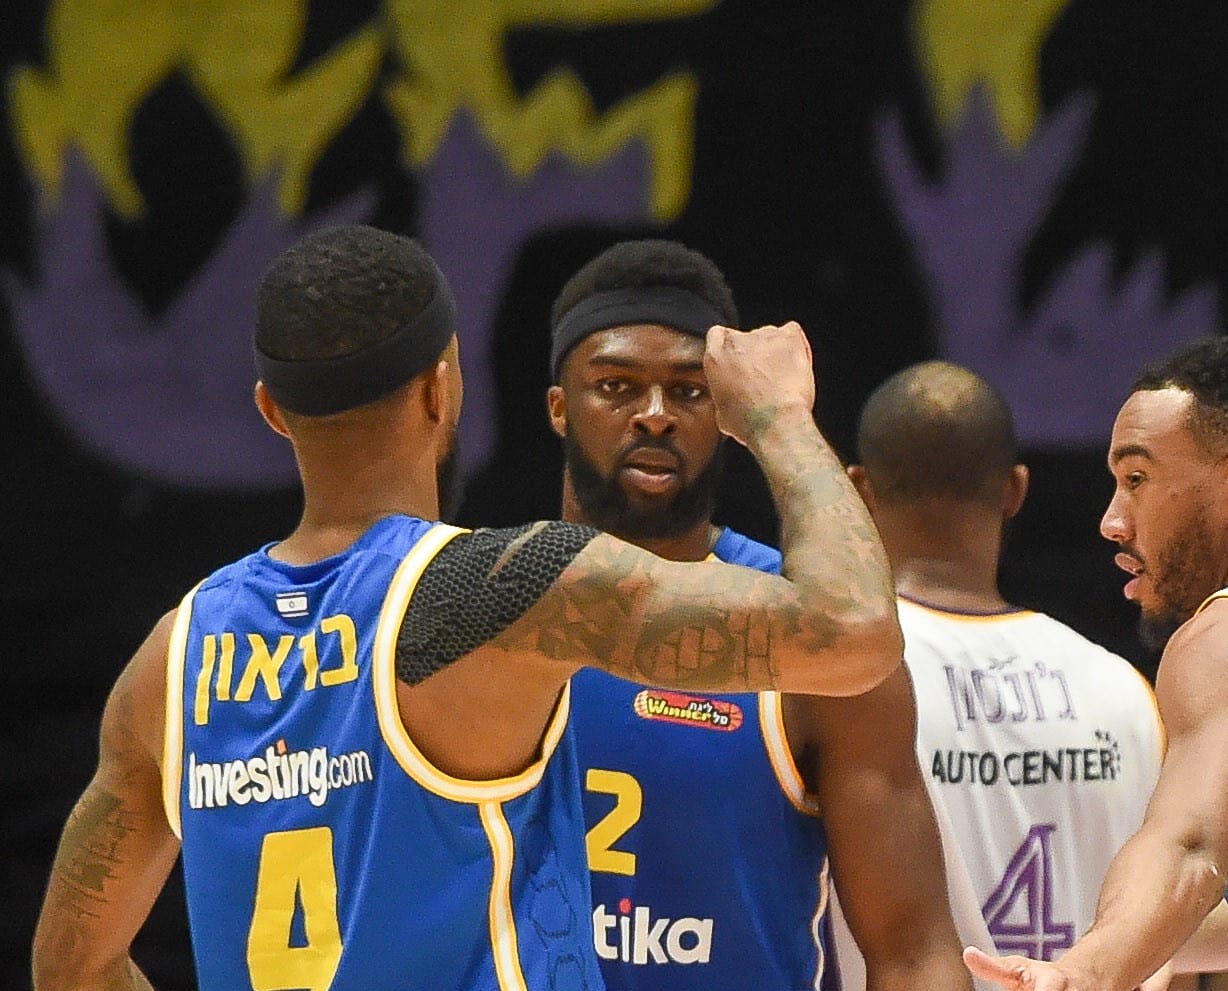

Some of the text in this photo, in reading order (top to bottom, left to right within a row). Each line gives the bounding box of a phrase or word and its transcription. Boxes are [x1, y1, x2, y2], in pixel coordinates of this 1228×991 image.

[648, 698, 729, 725] Winner סל
[189, 739, 372, 807] Investing.com
[932, 748, 1116, 785] AUTO CENTER
[981, 823, 1076, 959] 4
